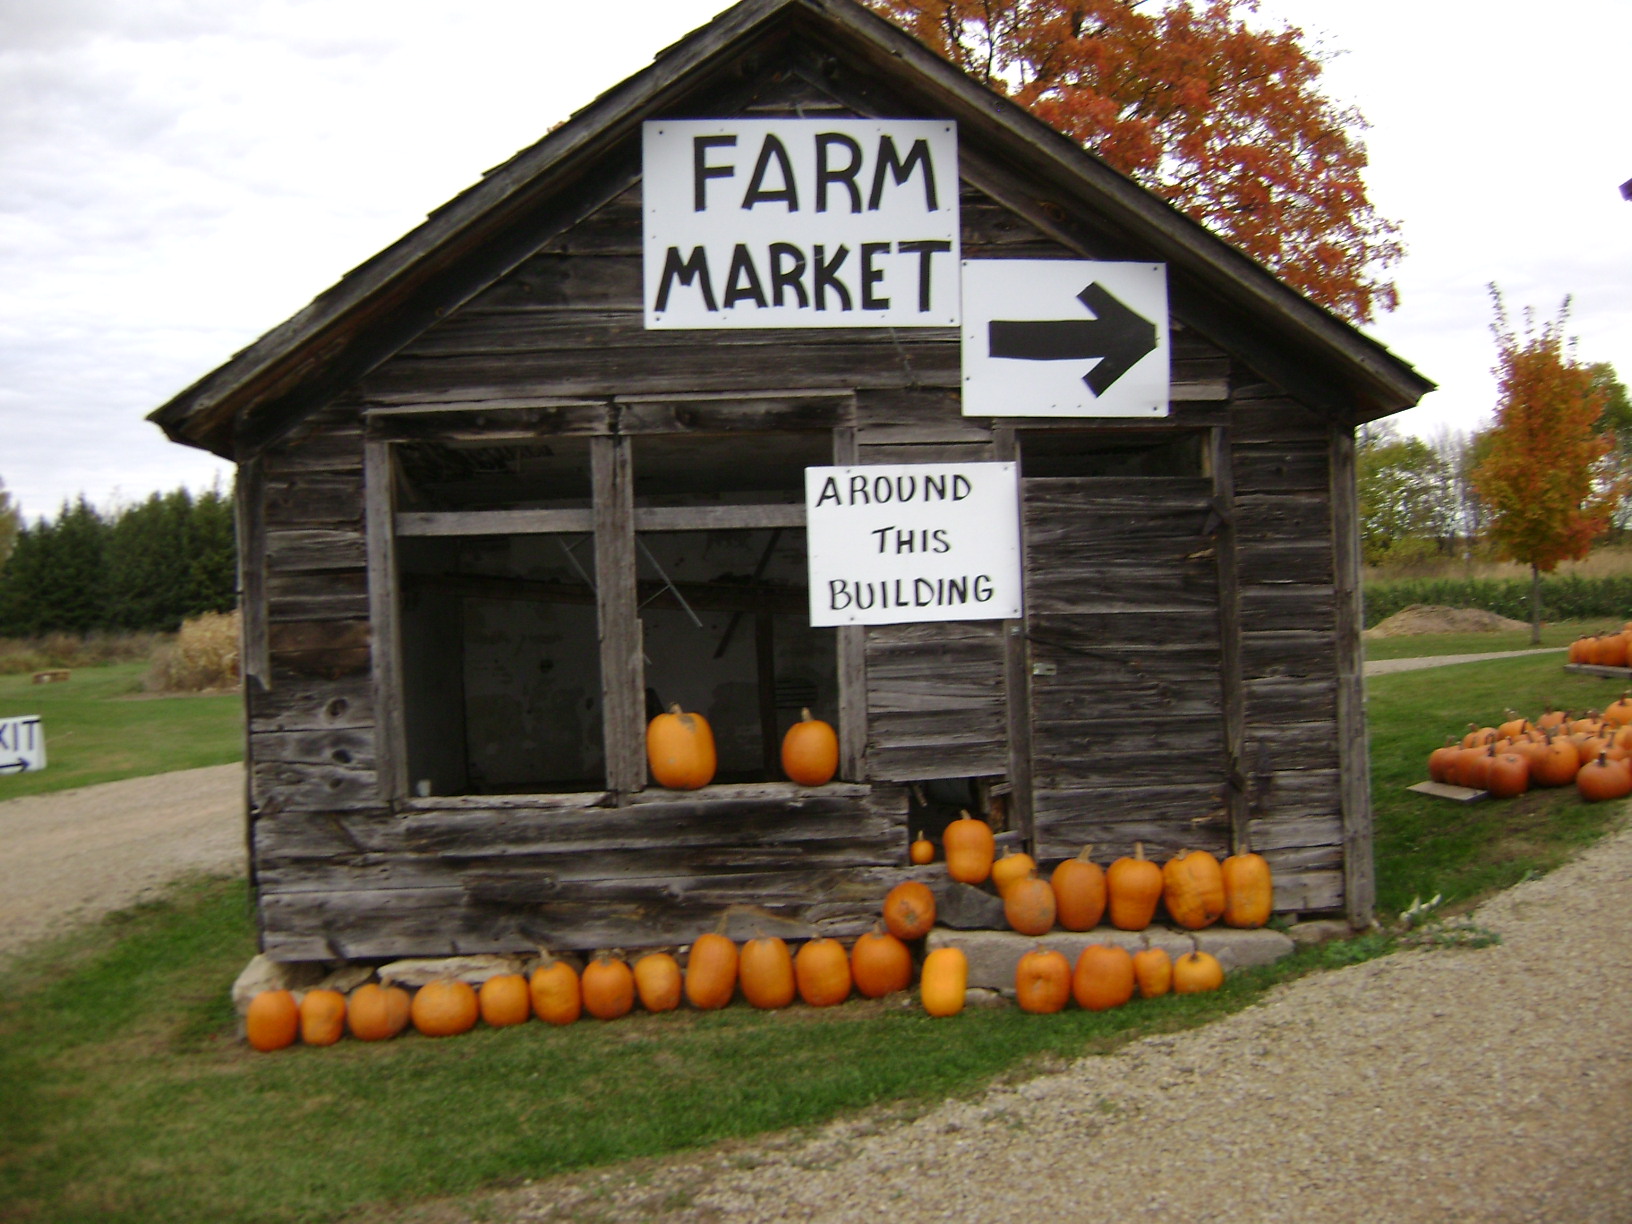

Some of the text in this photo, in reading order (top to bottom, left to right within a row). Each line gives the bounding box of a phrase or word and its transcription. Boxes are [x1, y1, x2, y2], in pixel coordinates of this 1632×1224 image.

[693, 132, 939, 214] FARM
[655, 240, 952, 312] MARKET
[816, 475, 971, 507] AROUND
[872, 527, 951, 555] THIS
[829, 575, 994, 611] BUILDING
